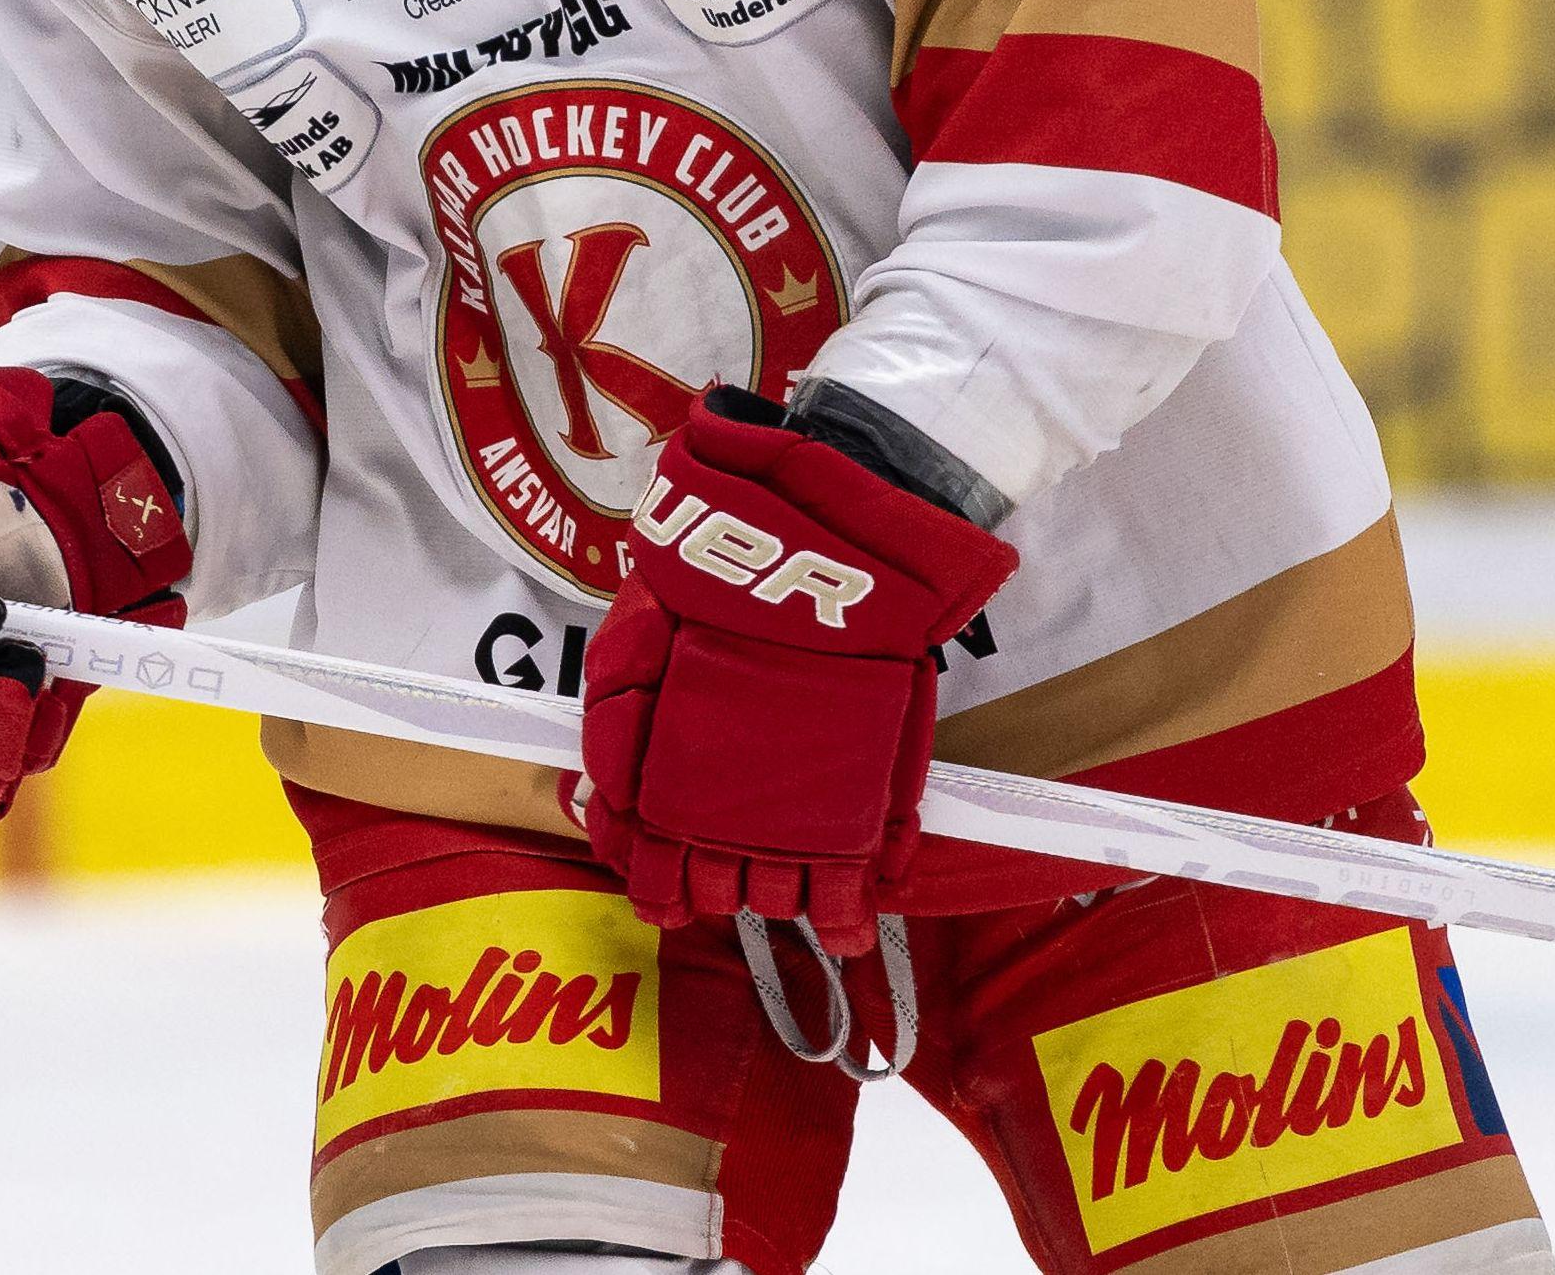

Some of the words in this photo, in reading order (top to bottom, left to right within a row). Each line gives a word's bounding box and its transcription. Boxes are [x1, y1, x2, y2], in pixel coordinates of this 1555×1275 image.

[277, 111, 341, 157] unds
[317, 135, 353, 171] AB
[432, 150, 488, 315] KALMAR
[468, 104, 667, 179] HOCKEY
[674, 132, 790, 253] CLUB
[478, 436, 577, 559] ANSVAR
[322, 946, 641, 1106] Molins
[1070, 1017, 1426, 1203] Molins
